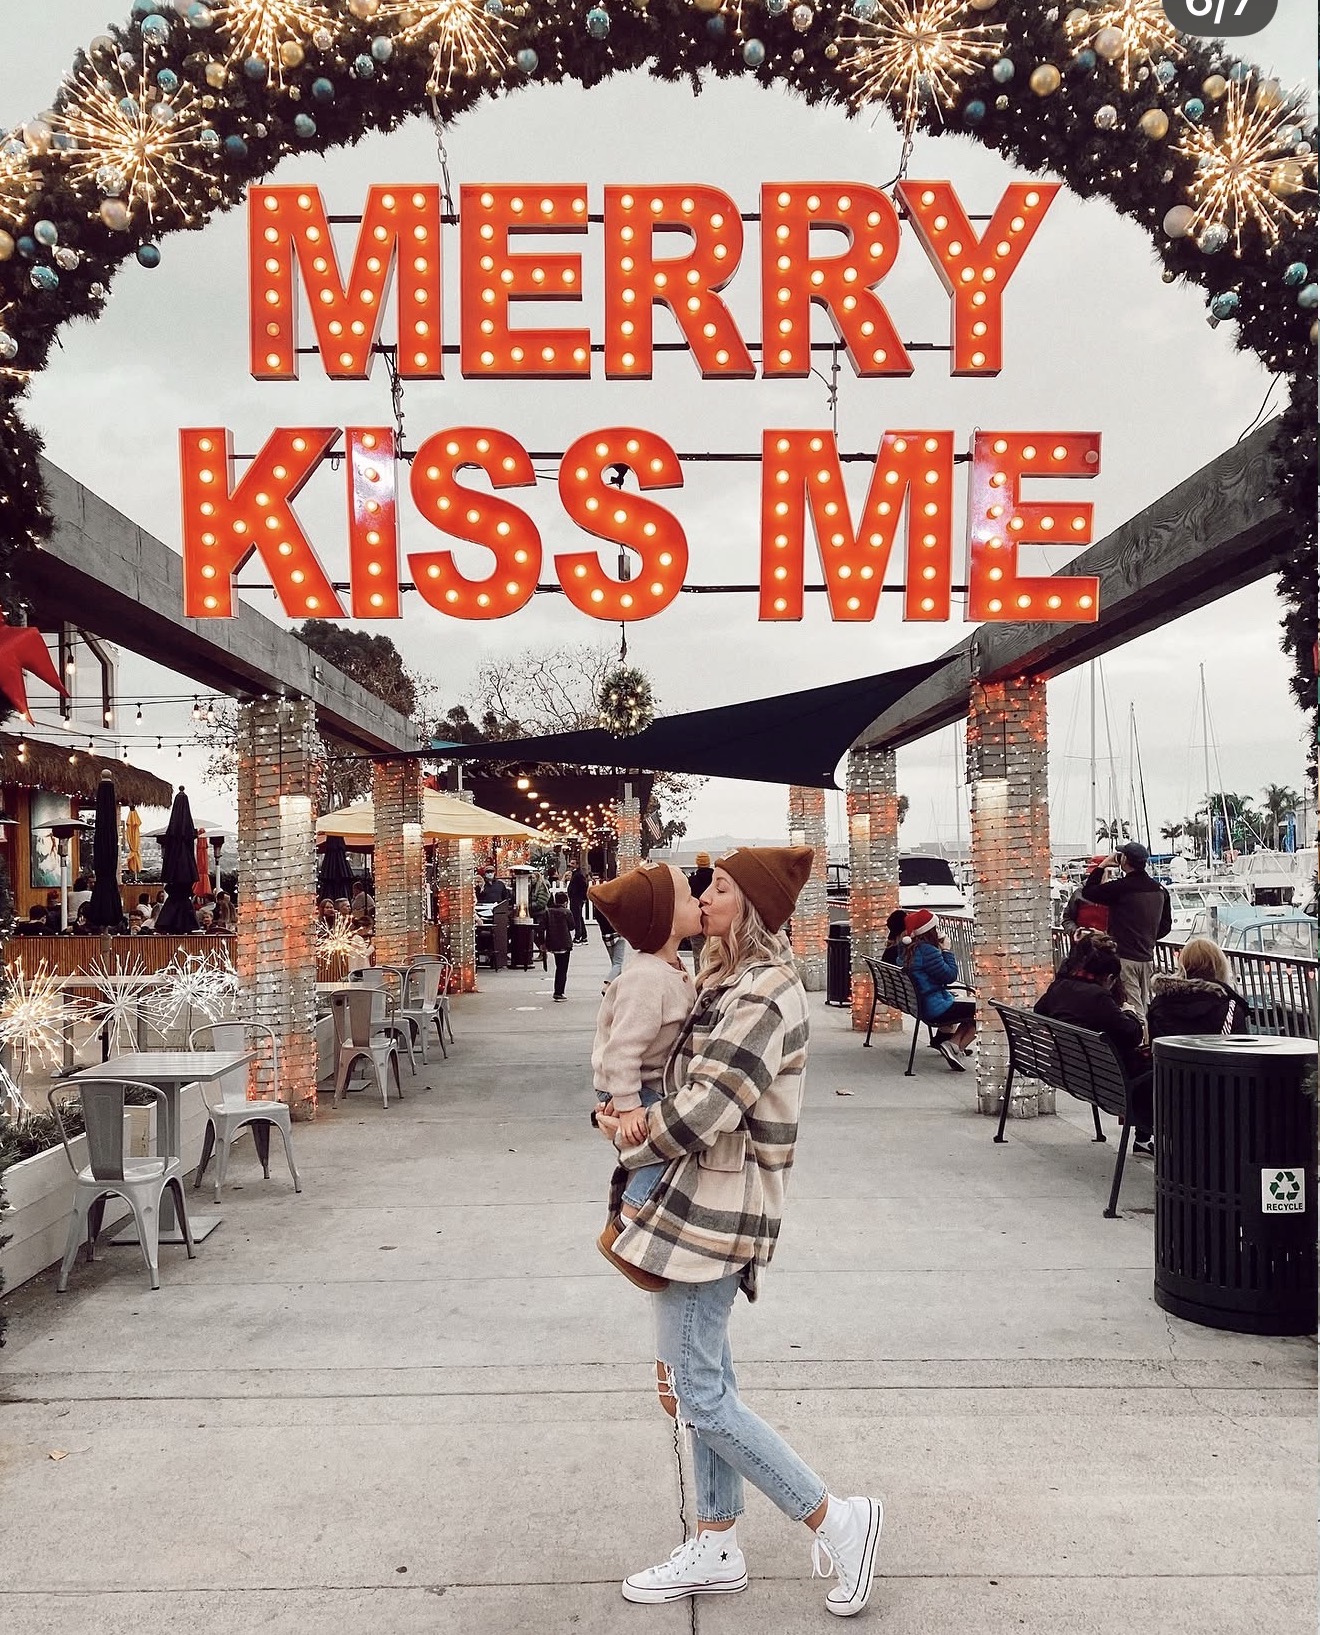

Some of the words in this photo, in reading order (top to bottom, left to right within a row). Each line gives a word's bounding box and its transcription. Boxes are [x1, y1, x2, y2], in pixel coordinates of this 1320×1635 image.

[248, 182, 1063, 380] MERRY
[180, 425, 691, 621] KISS
[758, 428, 1102, 623] ME
[1266, 1203, 1303, 1211] RECYCLE
